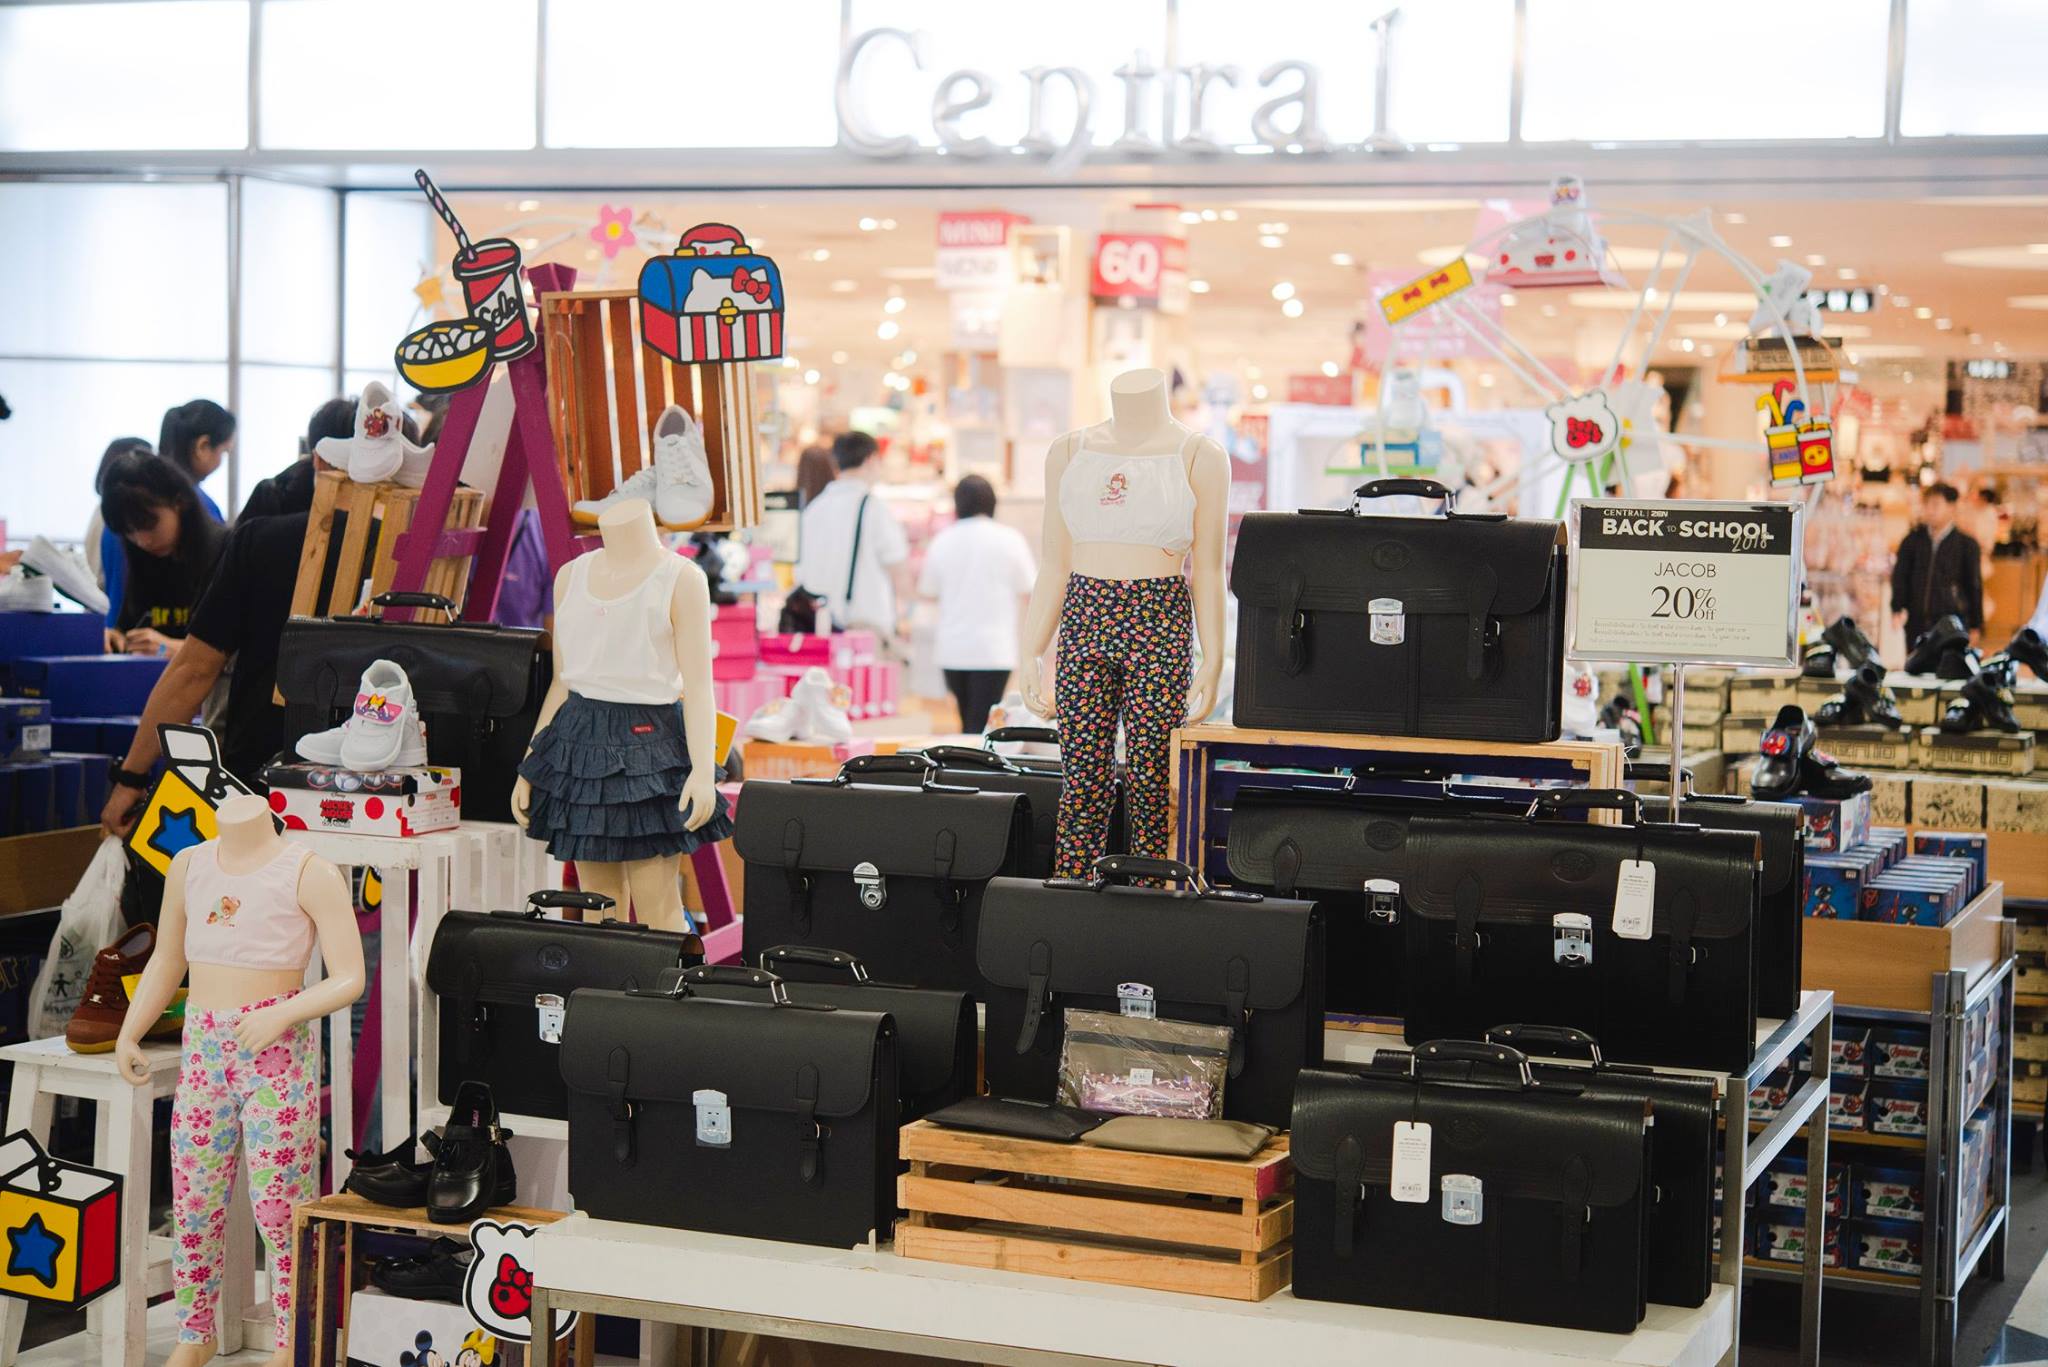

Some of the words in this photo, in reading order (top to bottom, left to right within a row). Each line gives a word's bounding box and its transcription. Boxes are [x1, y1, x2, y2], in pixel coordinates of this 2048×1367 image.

[835, 8, 1404, 172] Central
[1603, 508, 1645, 517] CENTRAL
[1650, 510, 1668, 518] ZEN
[1602, 518, 1664, 537] BACK
[1667, 525, 1676, 533] TO
[1679, 520, 1774, 540] SCHOOL
[1654, 562, 1717, 578] JACOB
[1651, 585, 1717, 619] 20%
[1694, 608, 1717, 621] Off
